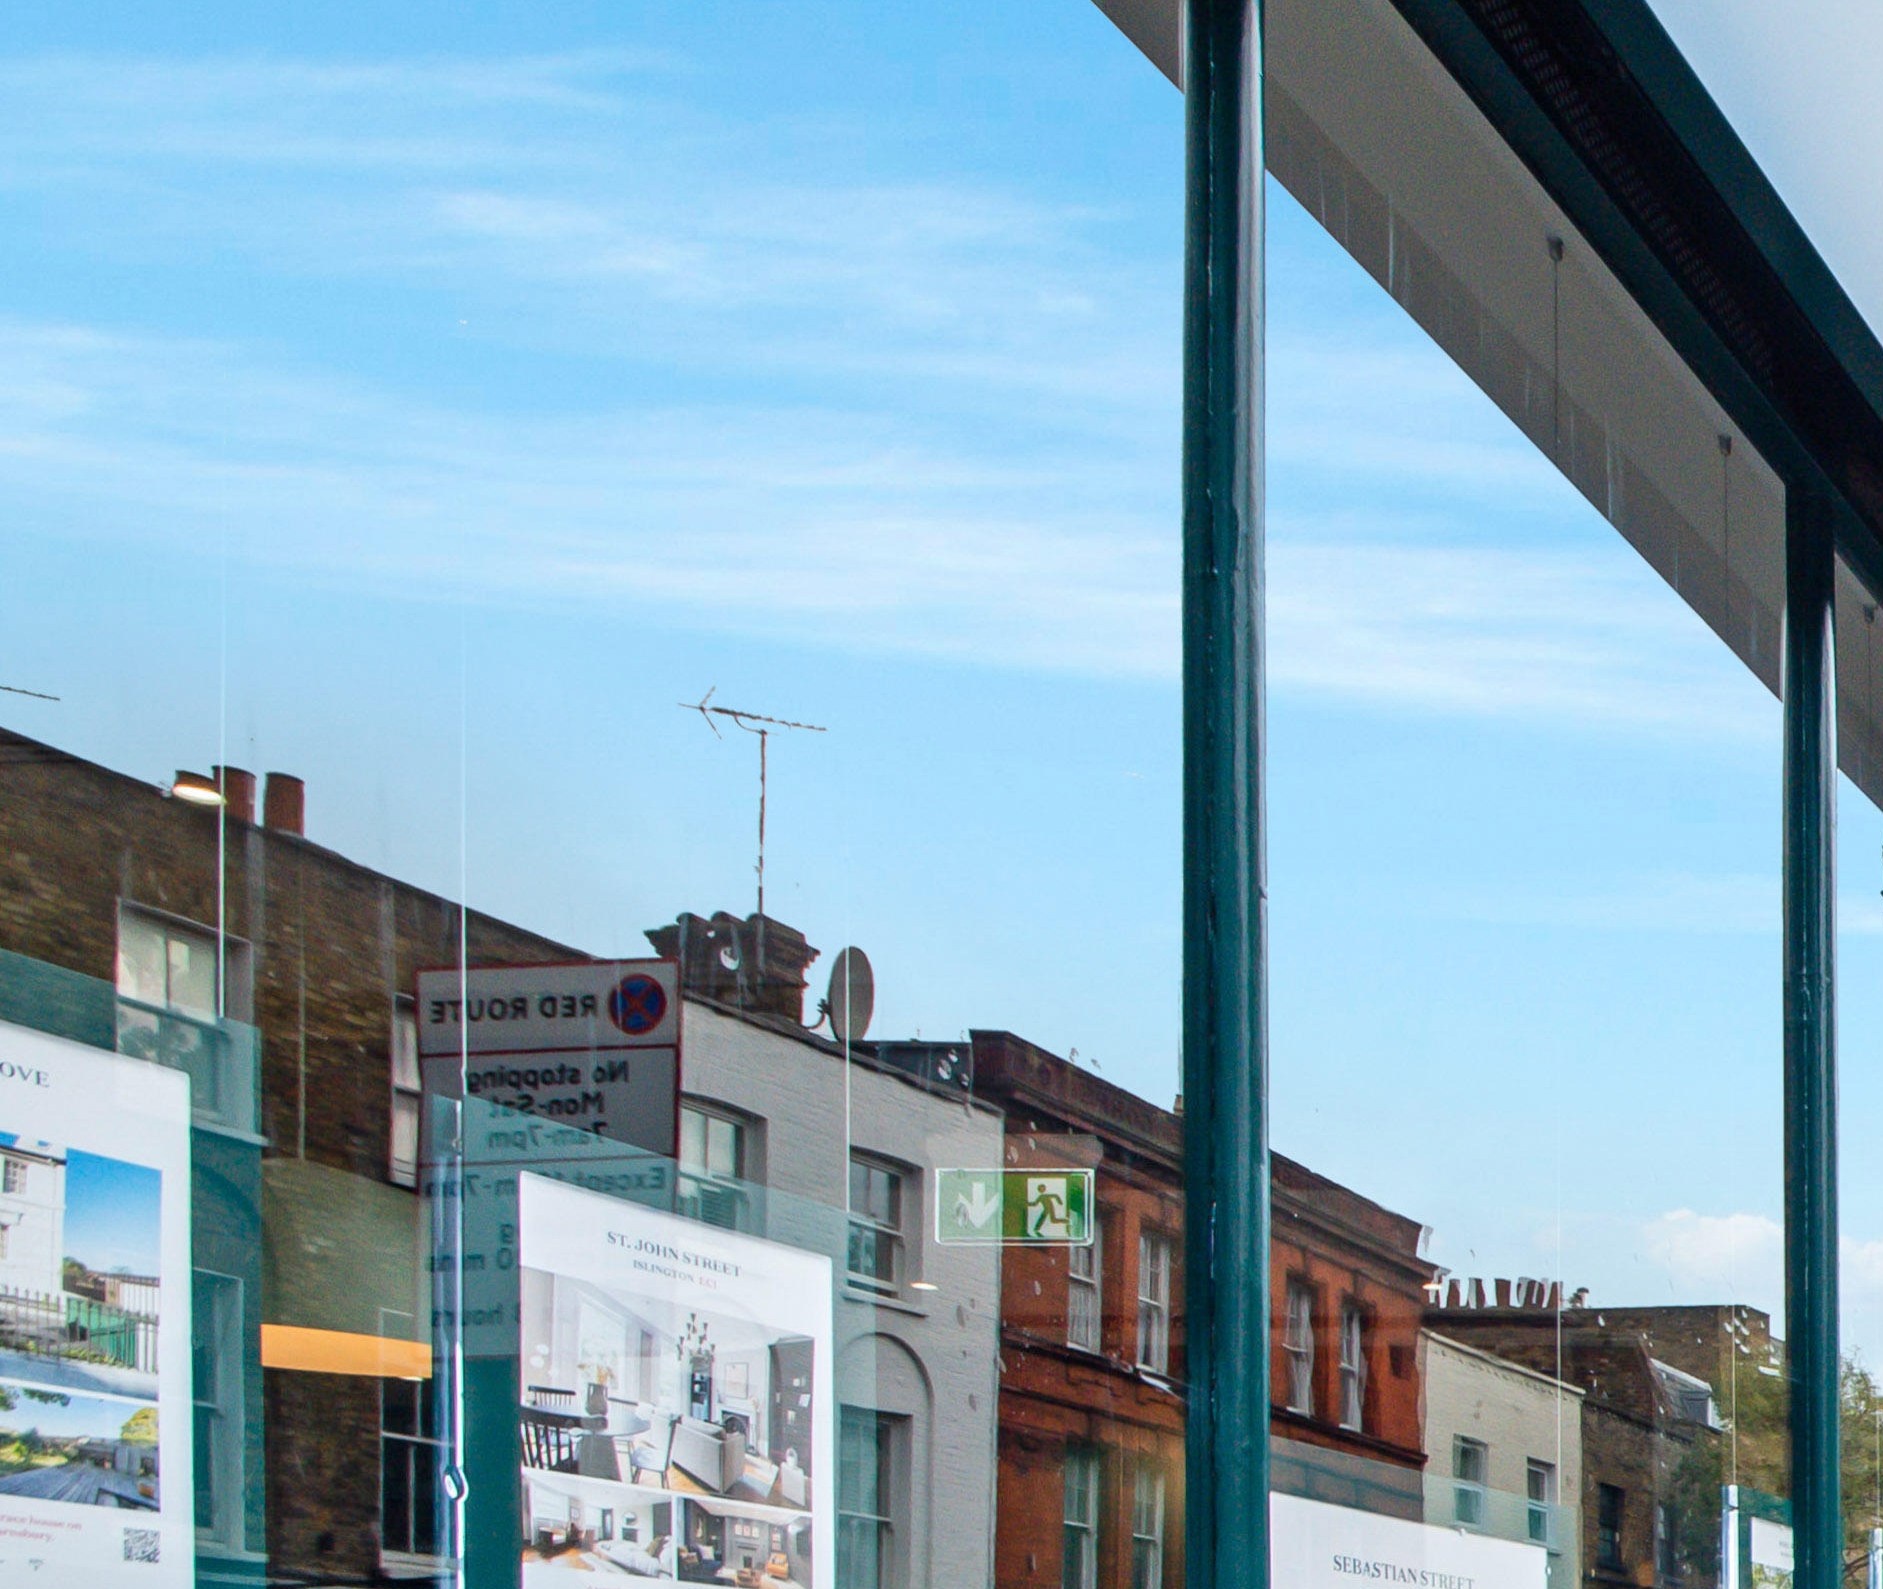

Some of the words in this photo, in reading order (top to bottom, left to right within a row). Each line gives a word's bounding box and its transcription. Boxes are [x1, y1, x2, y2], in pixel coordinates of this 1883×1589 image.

[632, 1259, 694, 1283] ISLINGTON
[634, 1239, 679, 1260] JOHN
[682, 1252, 741, 1277] STREET
[1333, 1554, 1417, 1584] SEBASTIAN
